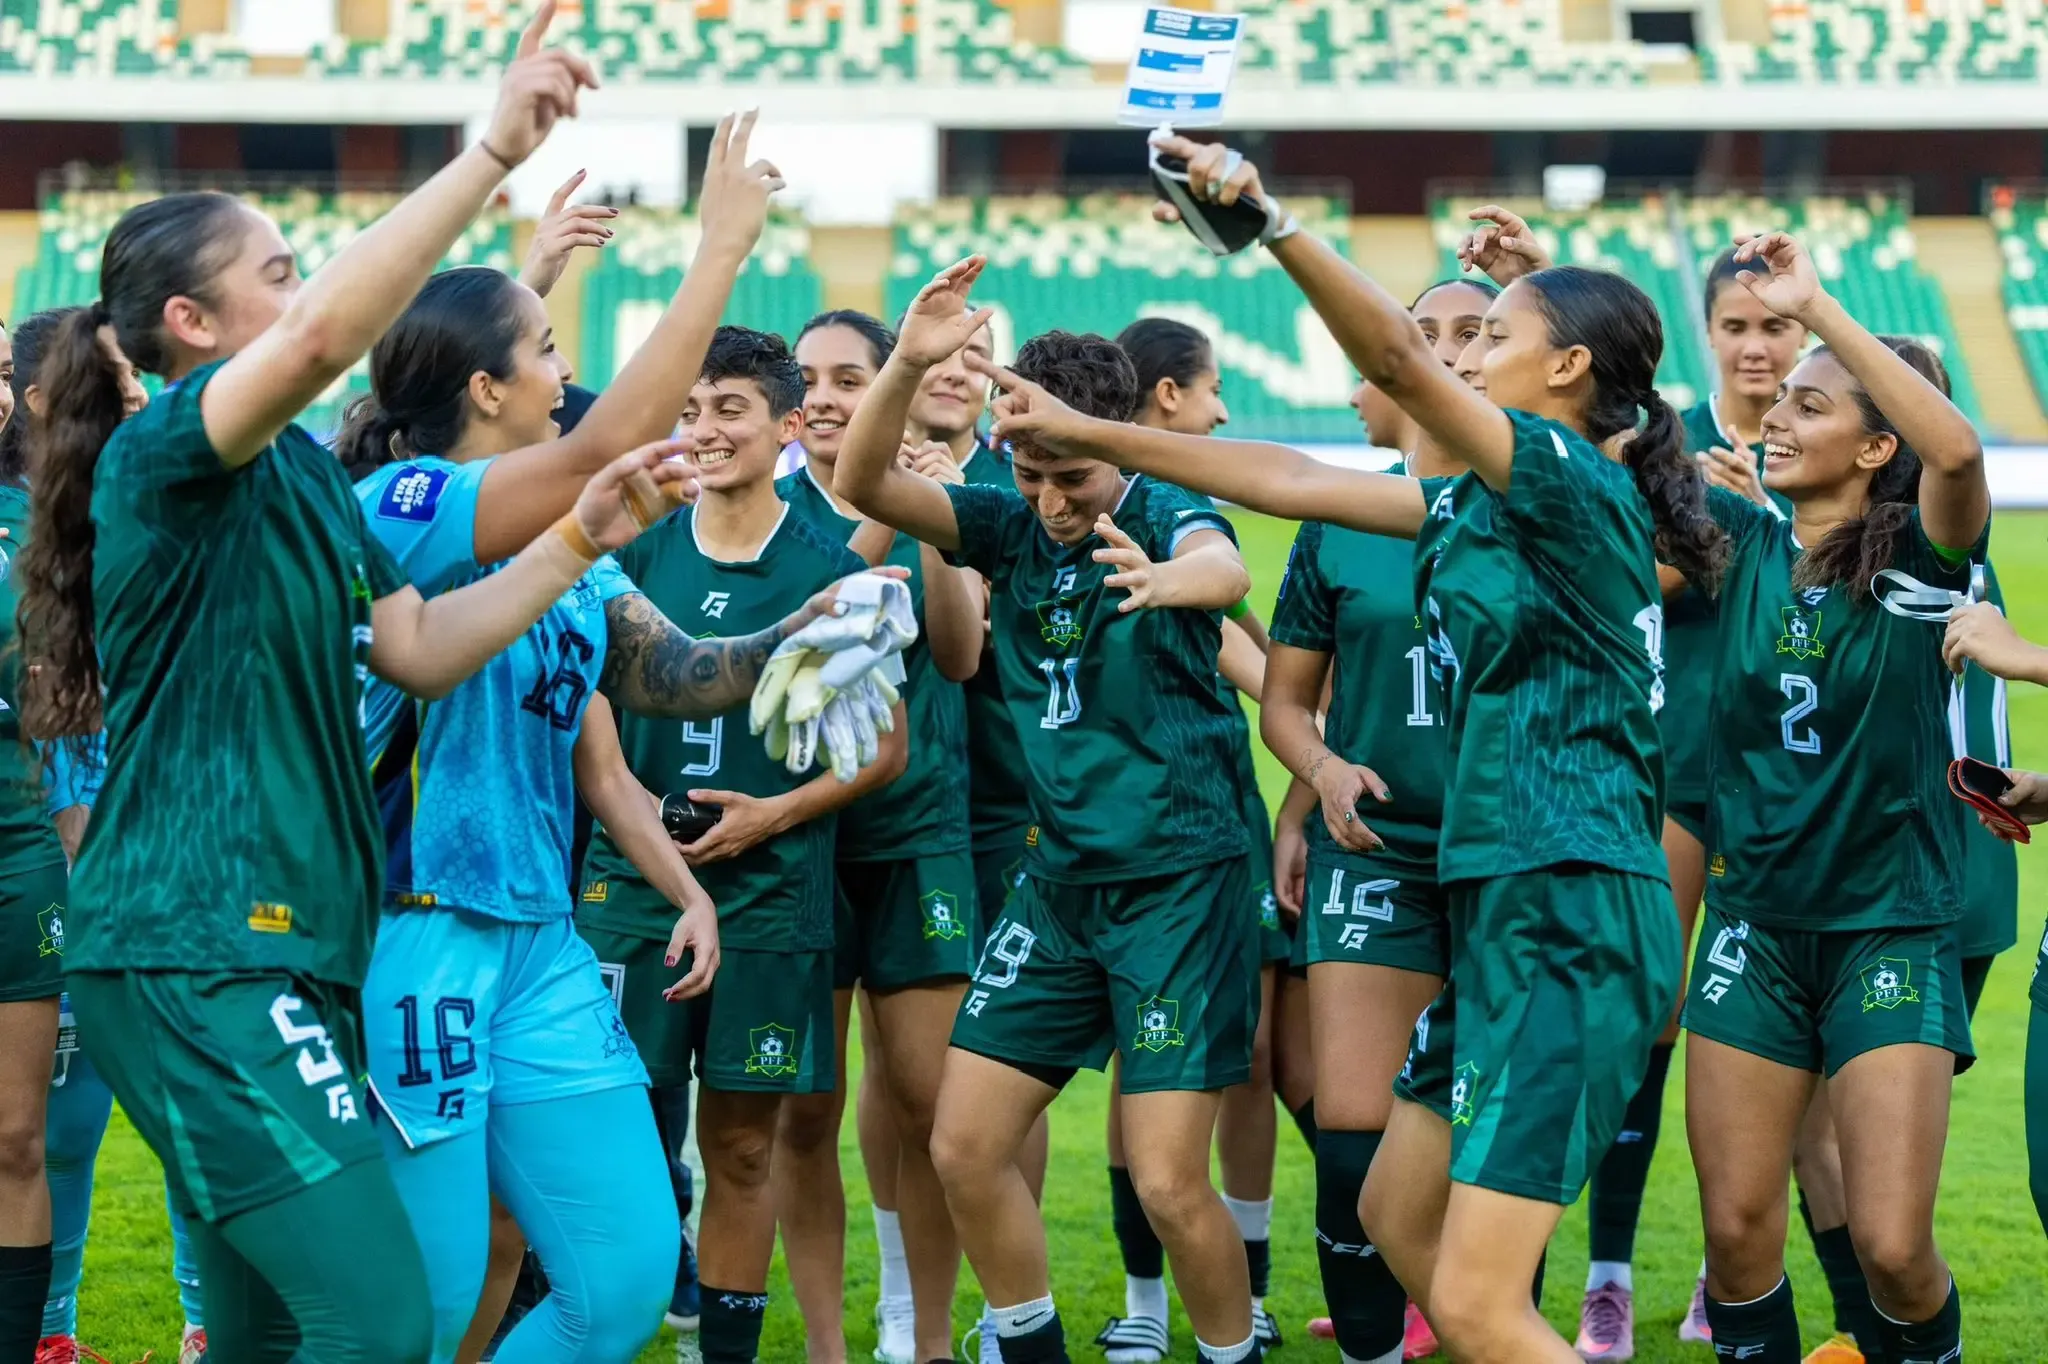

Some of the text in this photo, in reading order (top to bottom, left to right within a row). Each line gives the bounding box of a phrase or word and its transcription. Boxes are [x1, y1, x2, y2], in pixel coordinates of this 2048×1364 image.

[392, 477, 411, 503] FIFA
[400, 472, 425, 513] SERIES
[1052, 624, 1074, 637] PFF
[1791, 637, 1811, 649] PFF
[1405, 646, 1444, 726] 1
[1780, 673, 1821, 755] 2
[1875, 987, 1902, 1000] PFF
[394, 995, 477, 1087] 16
[1144, 1031, 1169, 1042] PFF
[760, 1056, 785, 1065] PFF
